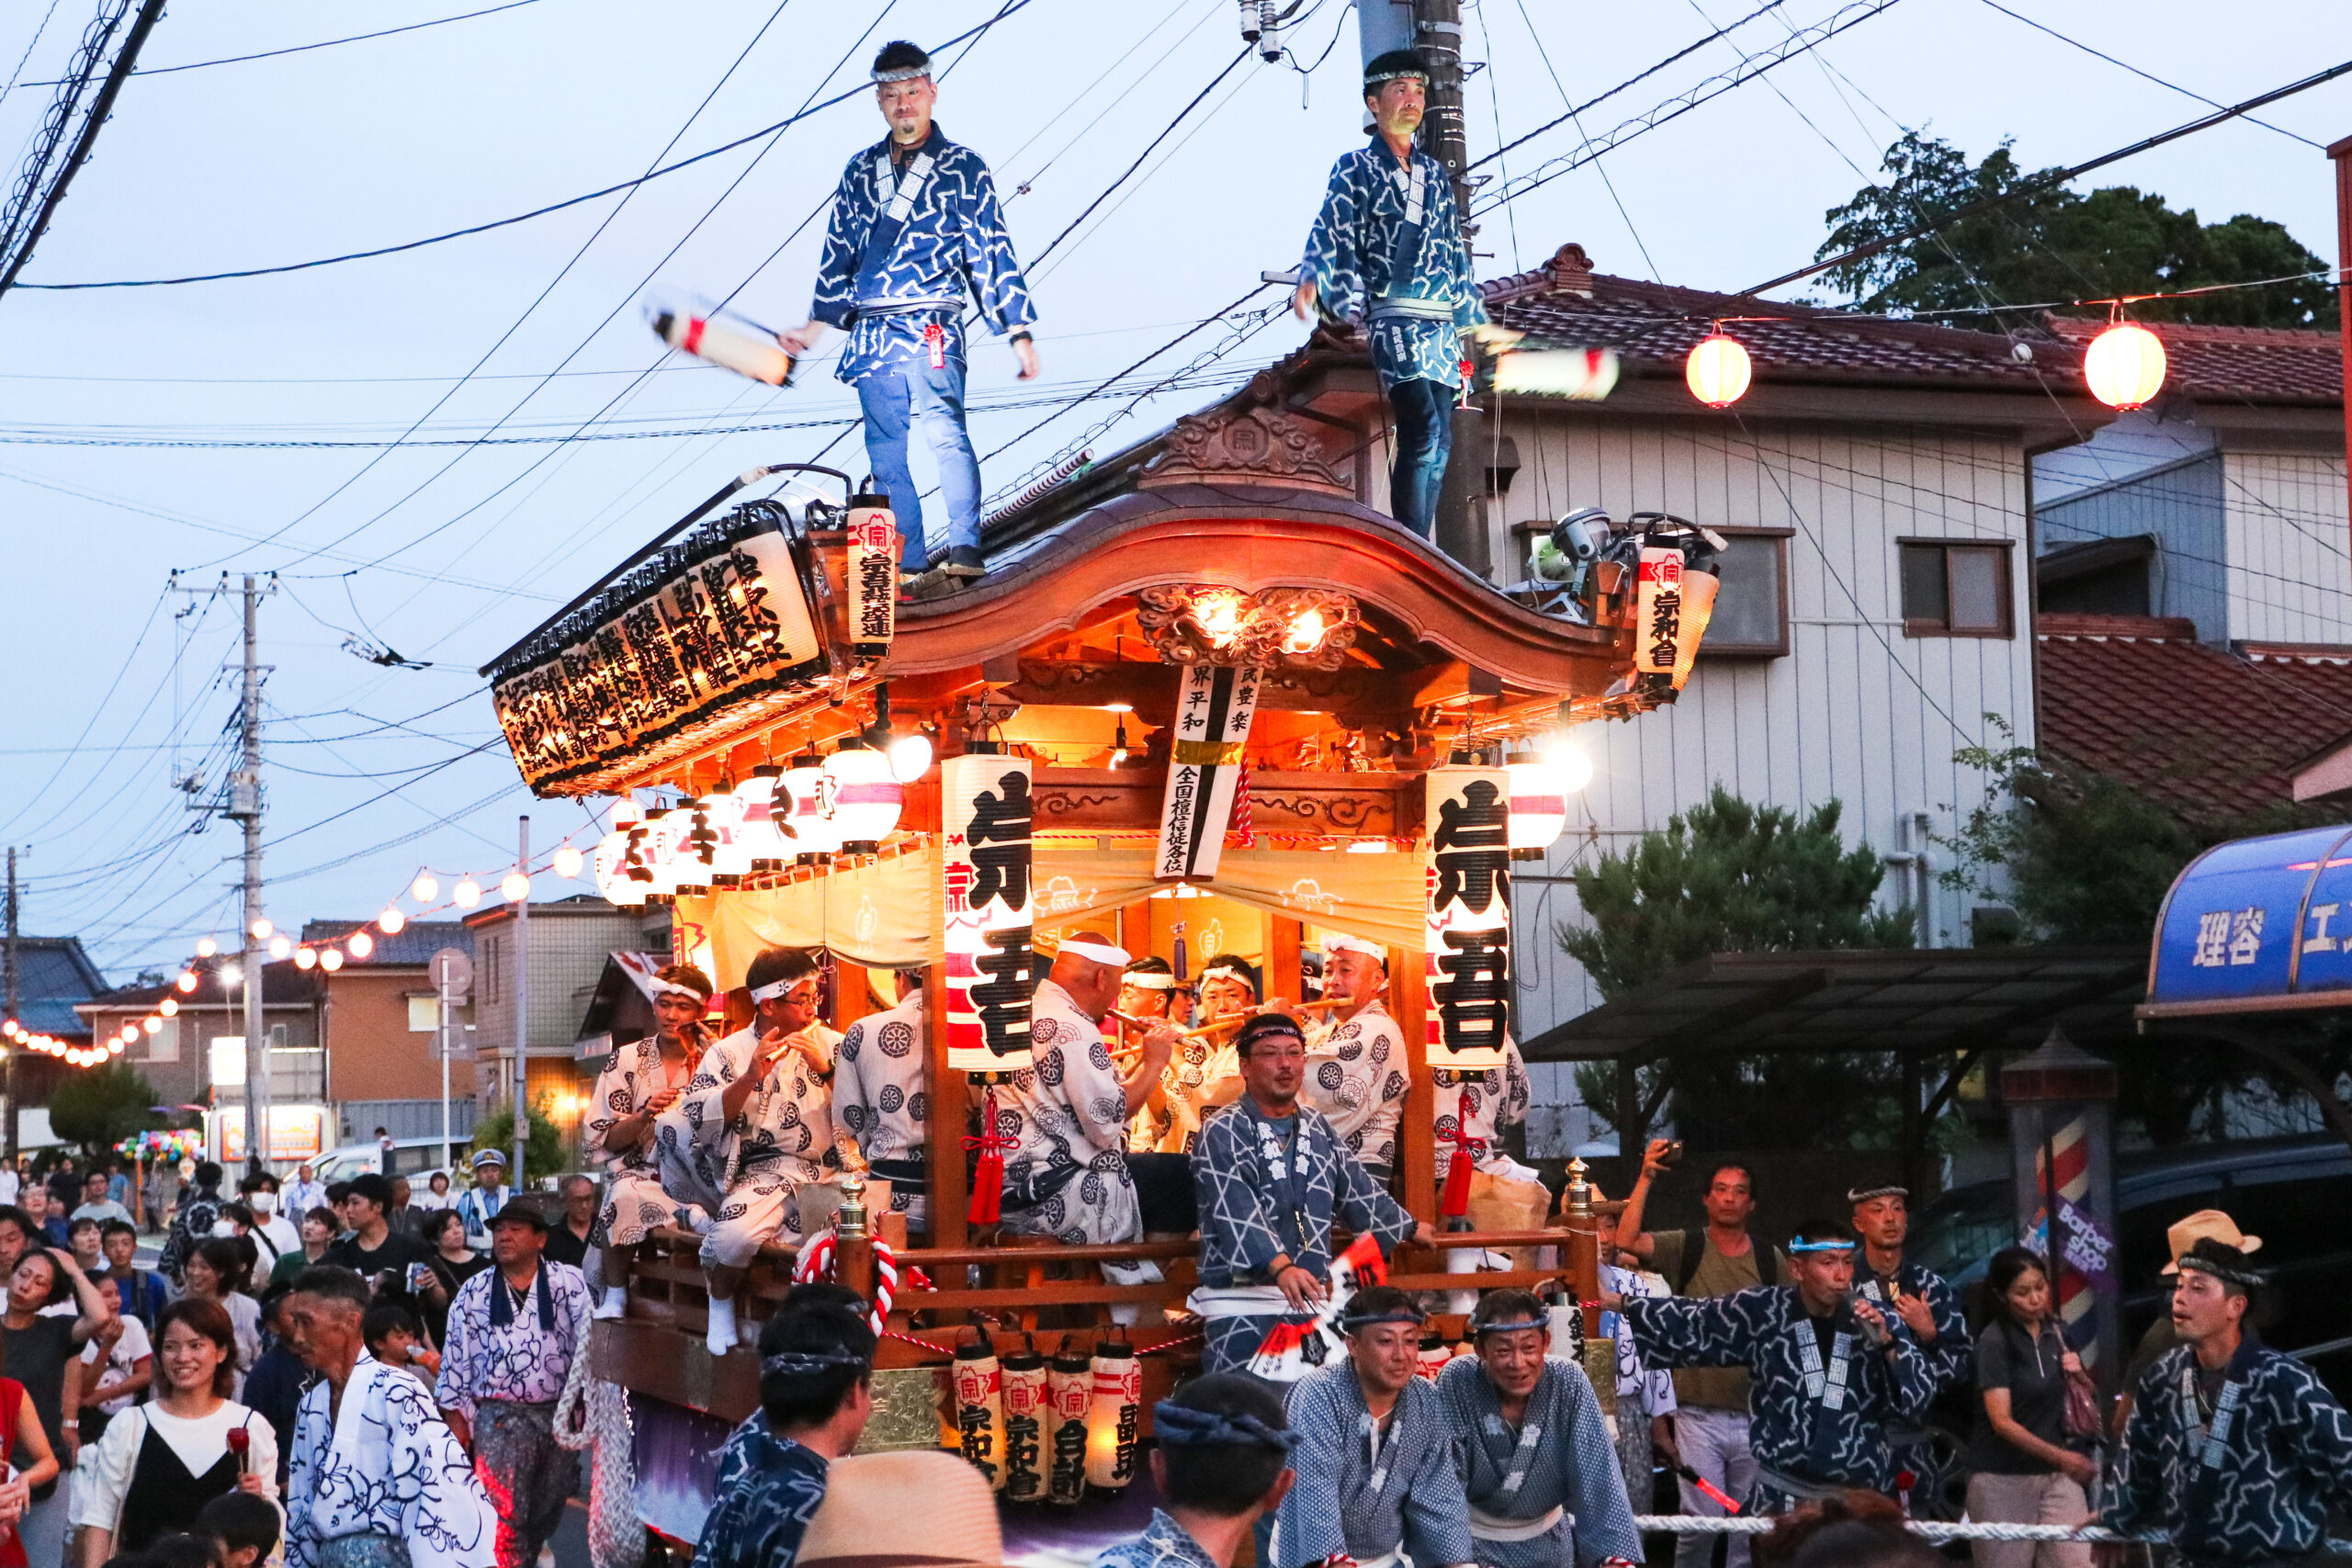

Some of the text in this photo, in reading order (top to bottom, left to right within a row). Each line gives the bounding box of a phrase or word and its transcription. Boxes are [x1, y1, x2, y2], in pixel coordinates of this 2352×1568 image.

[1163, 765, 1198, 874] 全国檀信徒各位
[1432, 779, 1510, 1055] 宗吾
[2192, 906, 2266, 967] 理容
[2058, 1203, 2113, 1253] Barber
[2067, 1235, 2108, 1271] shop
